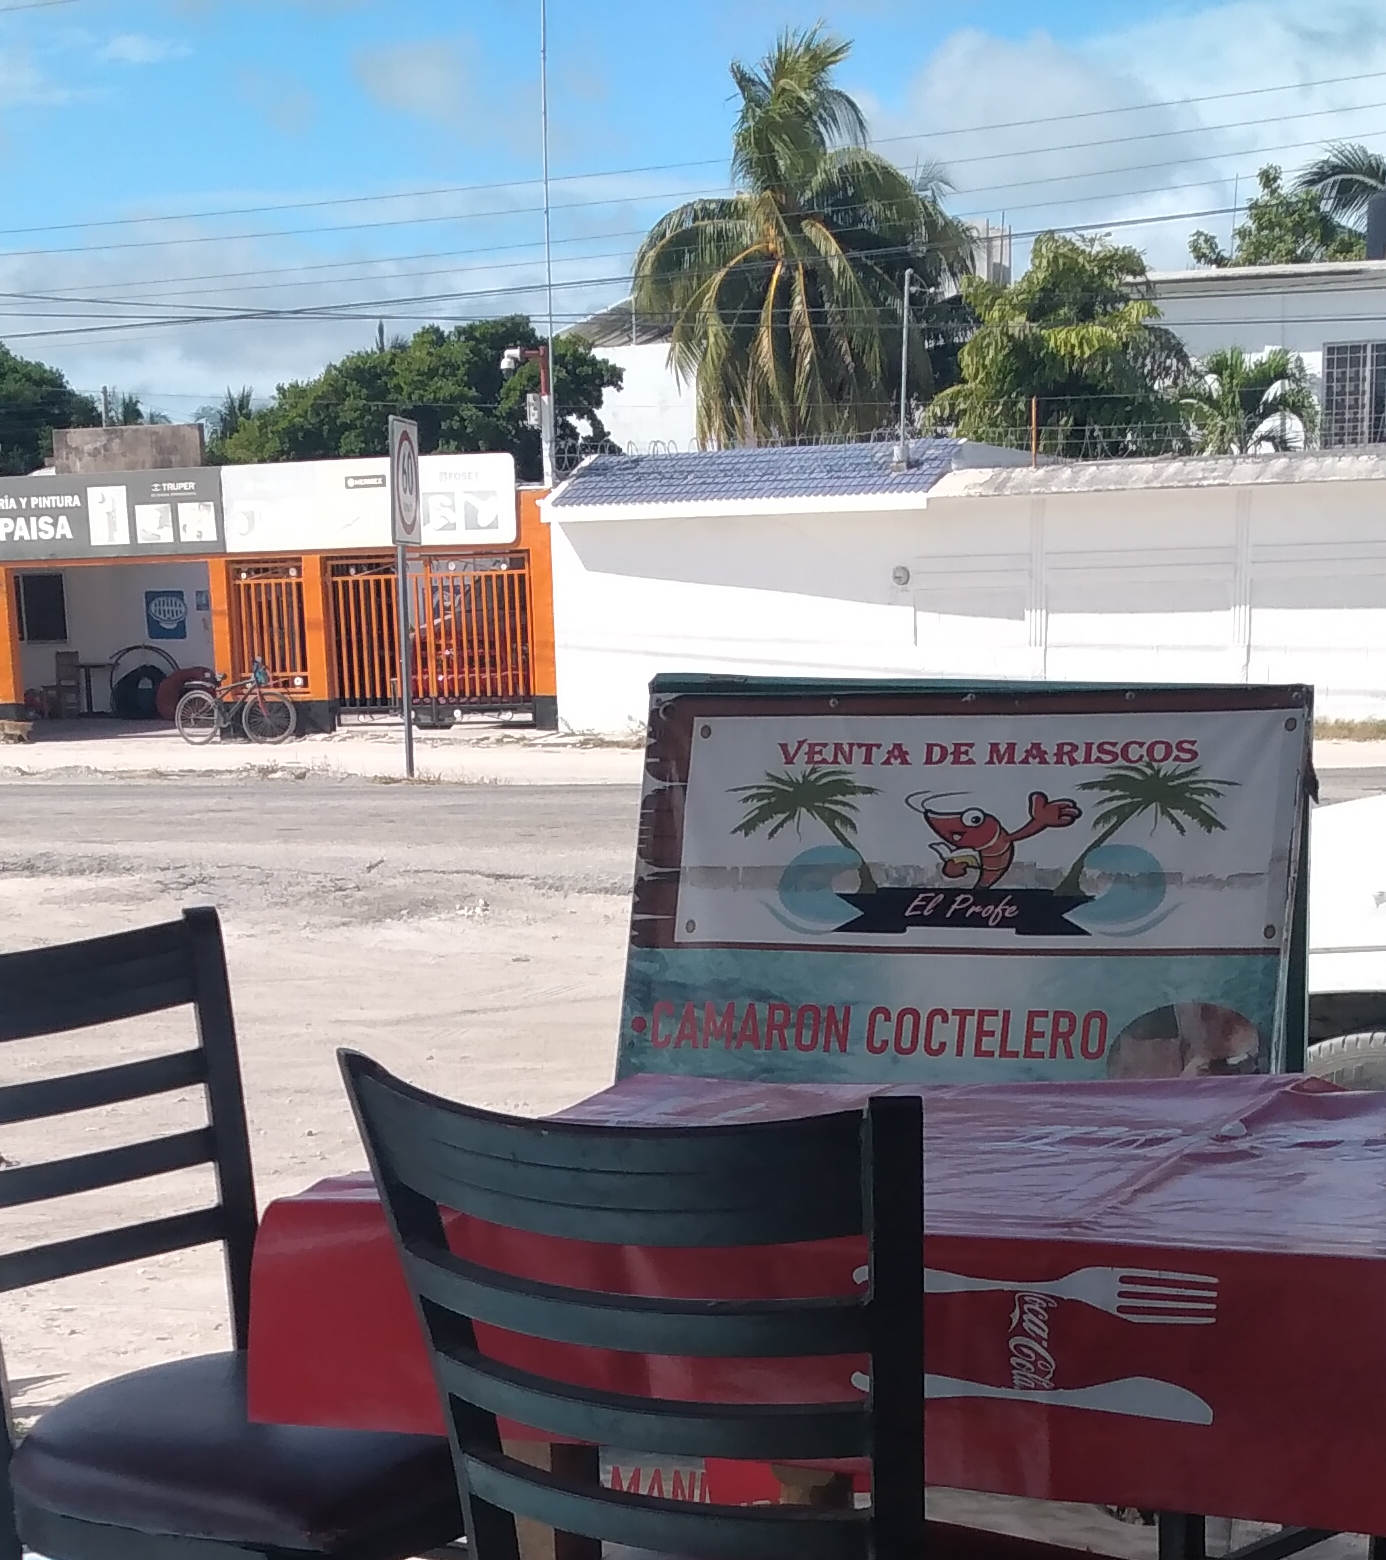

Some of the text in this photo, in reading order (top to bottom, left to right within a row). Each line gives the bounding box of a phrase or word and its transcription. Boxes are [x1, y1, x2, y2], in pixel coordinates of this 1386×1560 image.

[162, 482, 196, 490] TRUPER
[402, 452, 413, 495] 60
[448, 472, 480, 480] FOSET
[19, 497, 28, 509] Y
[30, 494, 81, 509] PINTURA
[778, 739, 1199, 767] VENTA DE MARISCOS
[904, 892, 1019, 926] El Profe
[650, 1000, 1109, 1061] CAMARON COCTELERO
